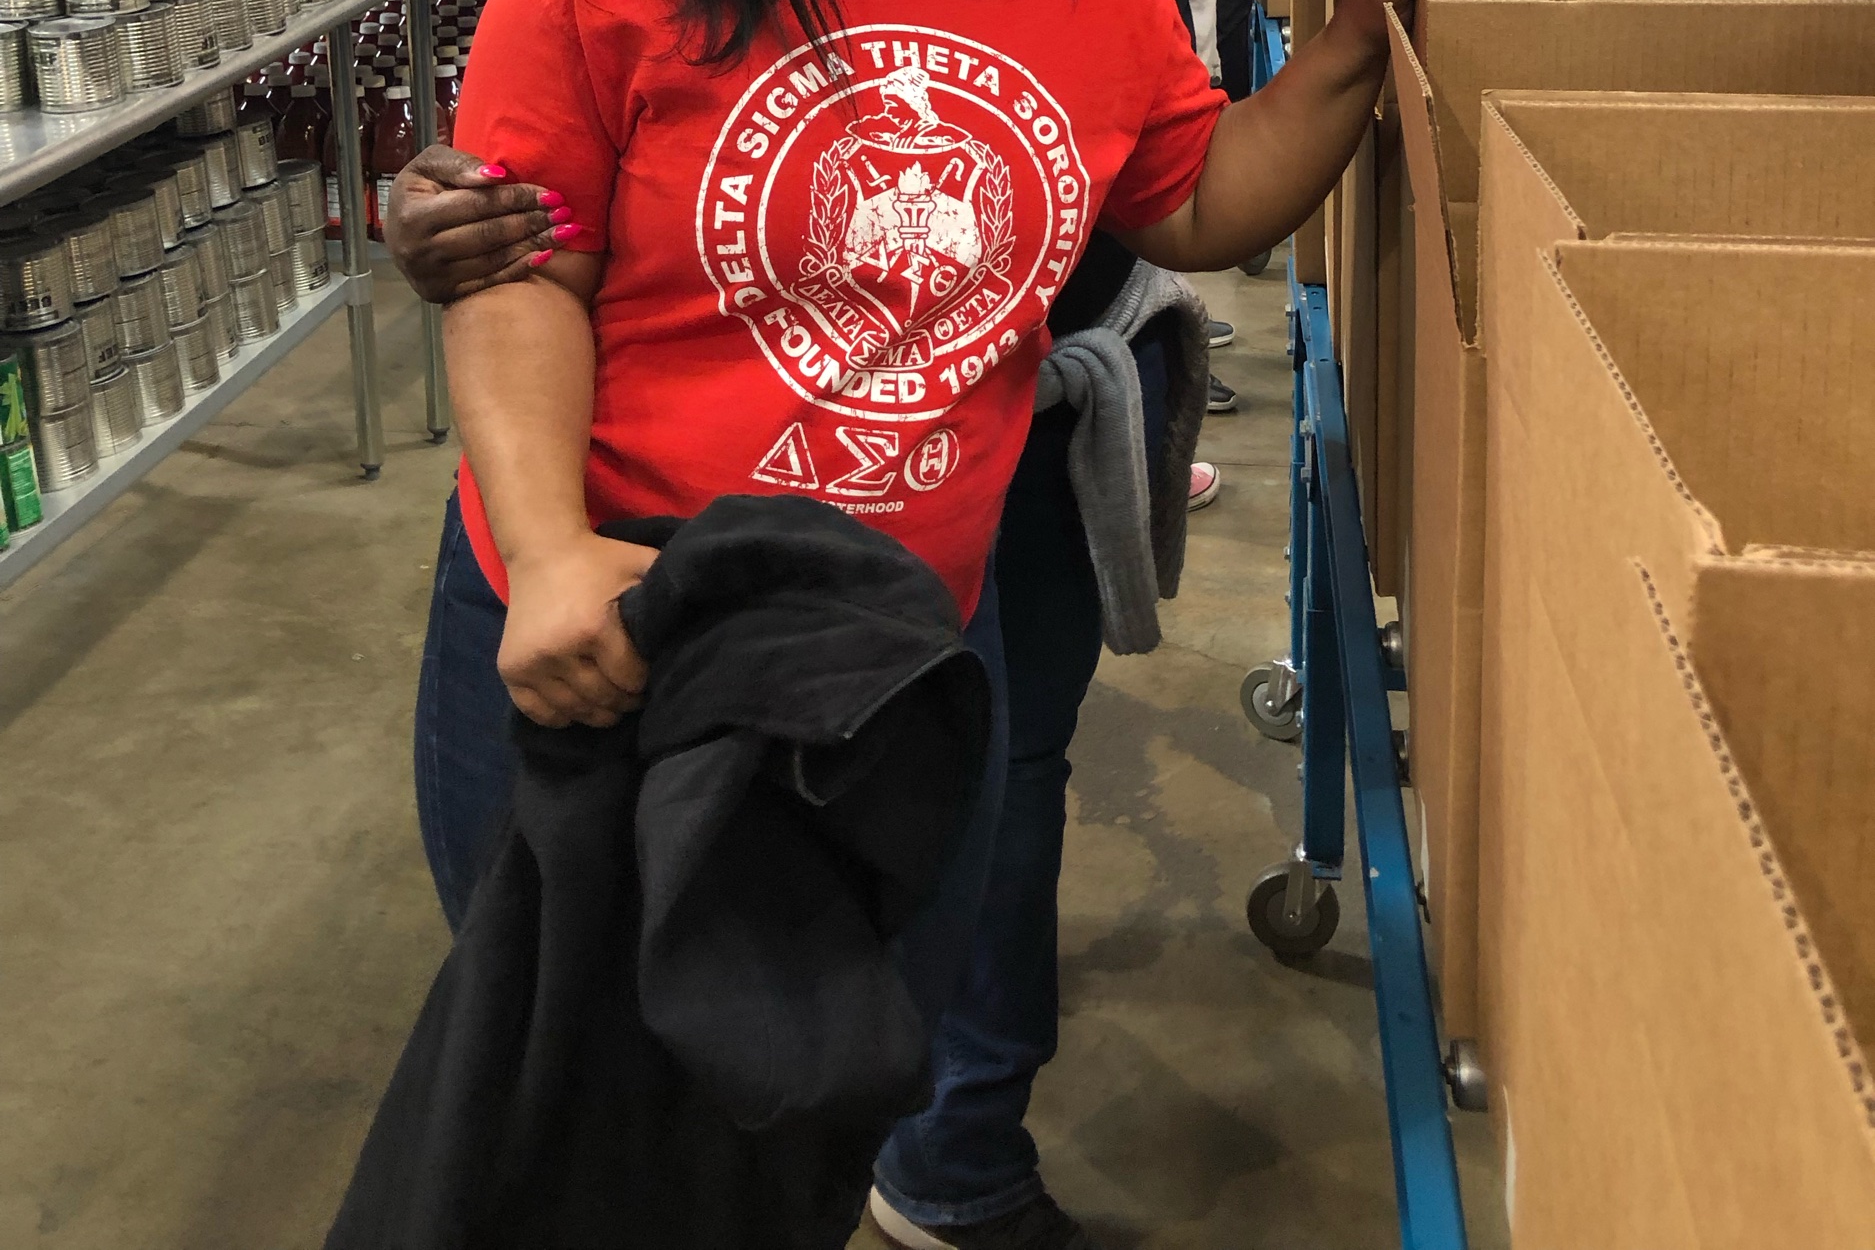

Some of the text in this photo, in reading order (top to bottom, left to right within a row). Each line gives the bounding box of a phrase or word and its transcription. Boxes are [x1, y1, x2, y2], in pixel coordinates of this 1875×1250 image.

[714, 40, 1079, 312] DELTA SIGMA THETA SORORITY
[763, 306, 1019, 404] FOUNDED 1913
[821, 499, 905, 515] TERHOOD
